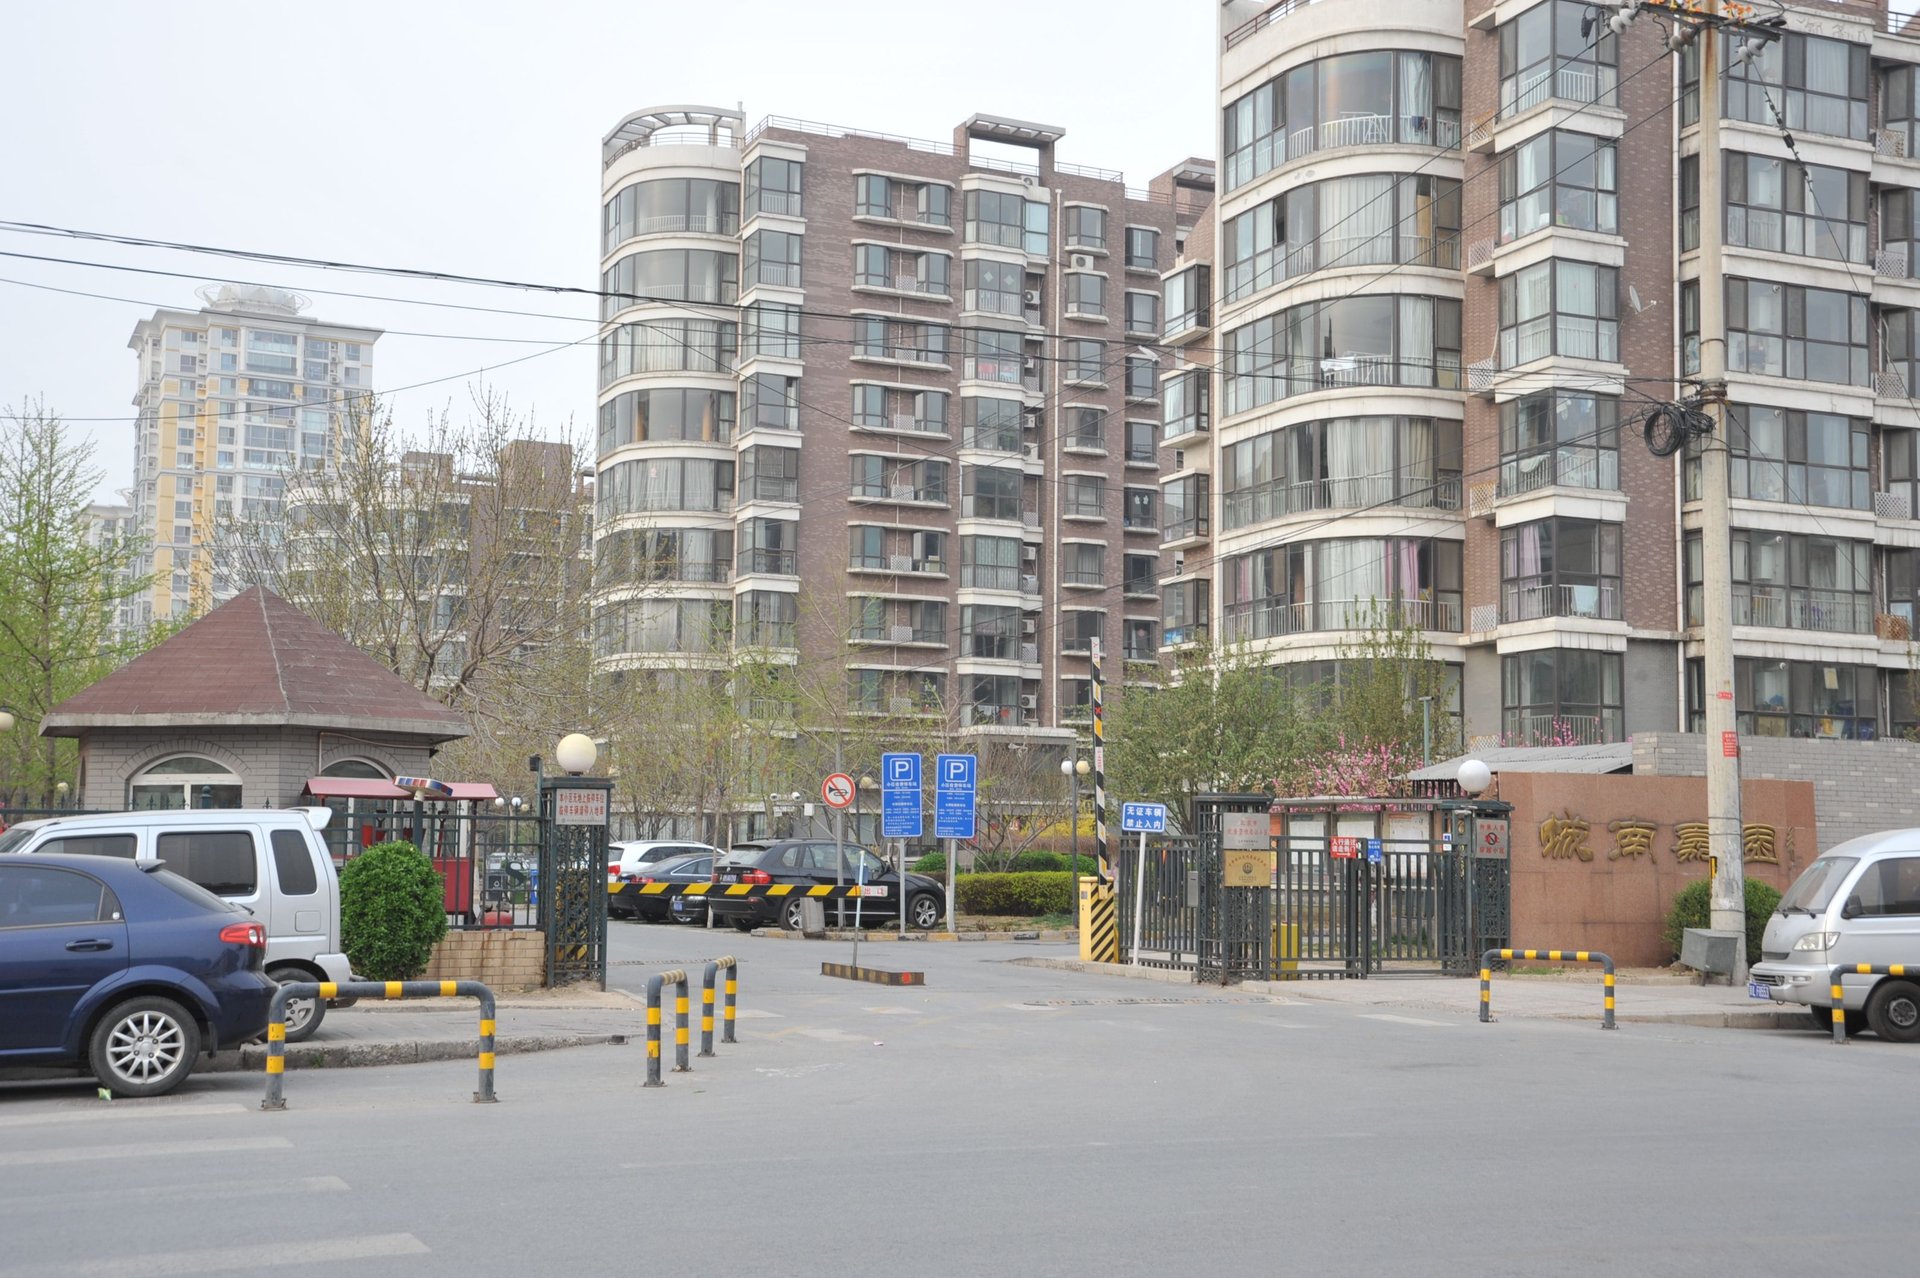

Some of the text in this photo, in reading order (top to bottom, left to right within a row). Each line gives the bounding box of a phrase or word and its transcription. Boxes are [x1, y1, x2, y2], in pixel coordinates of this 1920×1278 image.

[895, 761, 909, 779] P
[950, 762, 965, 780] P
[1127, 806, 1162, 817] 无证车辆
[1126, 819, 1161, 829] 禁止入内
